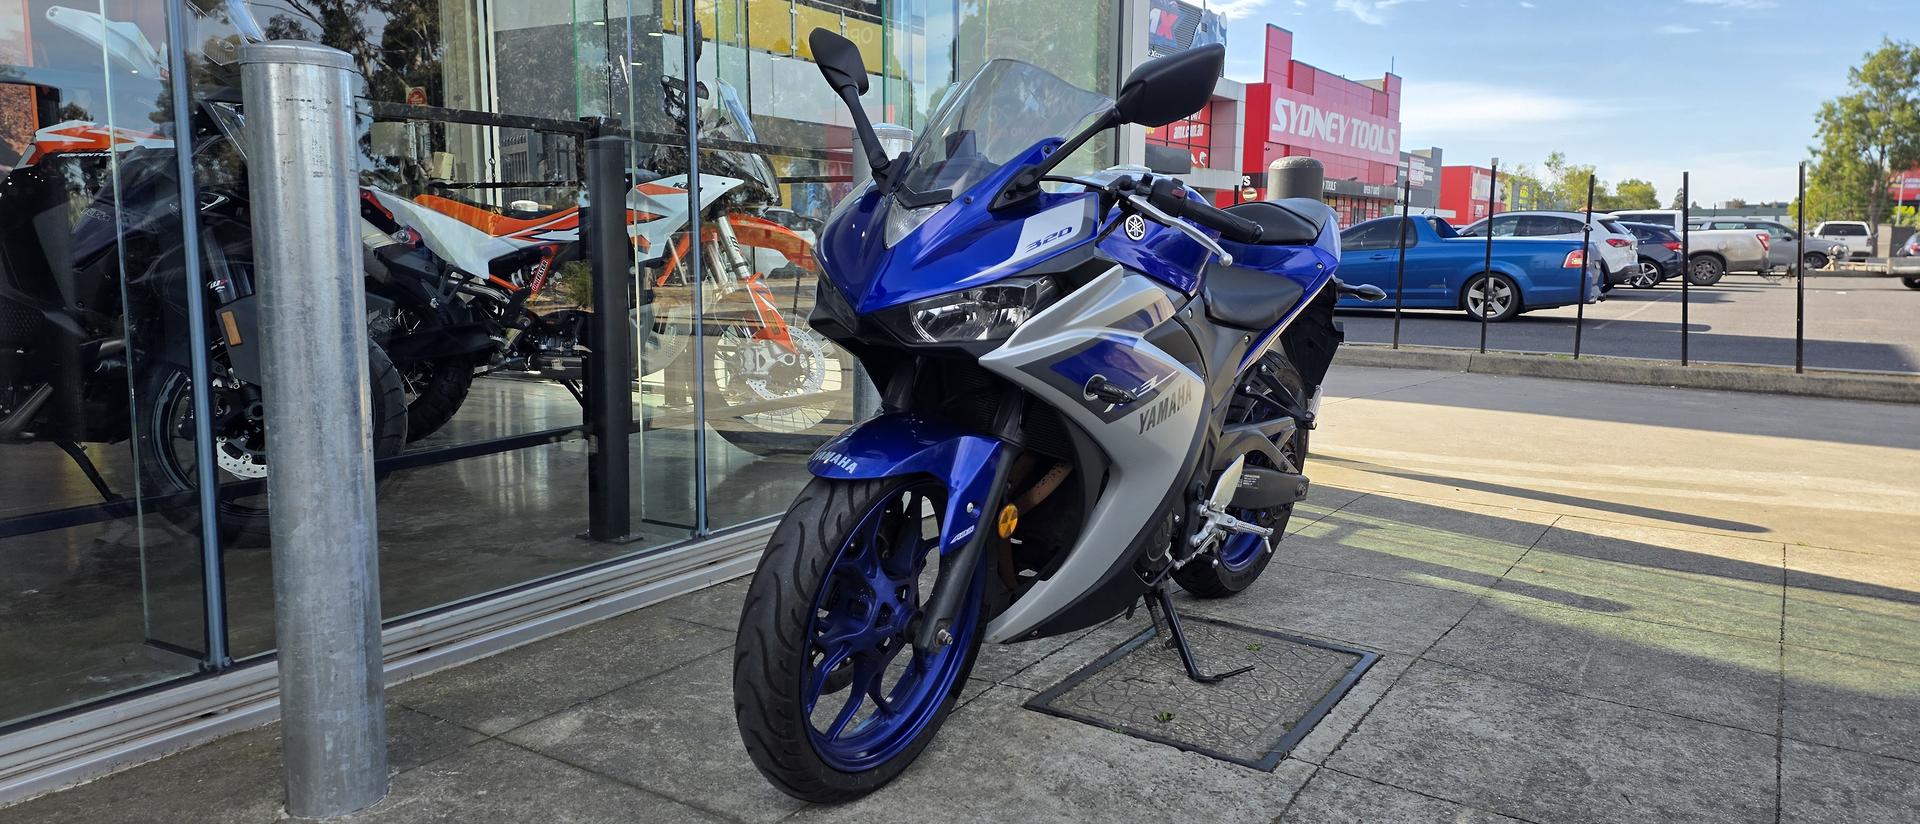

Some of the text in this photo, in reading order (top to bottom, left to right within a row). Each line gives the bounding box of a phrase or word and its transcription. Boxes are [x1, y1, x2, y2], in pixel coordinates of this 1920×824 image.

[1271, 96, 1397, 156] SYDNEY TOOLS
[1025, 226, 1073, 254] 320
[1138, 380, 1193, 436] YAMAHA
[812, 450, 859, 475] YAMAHA
